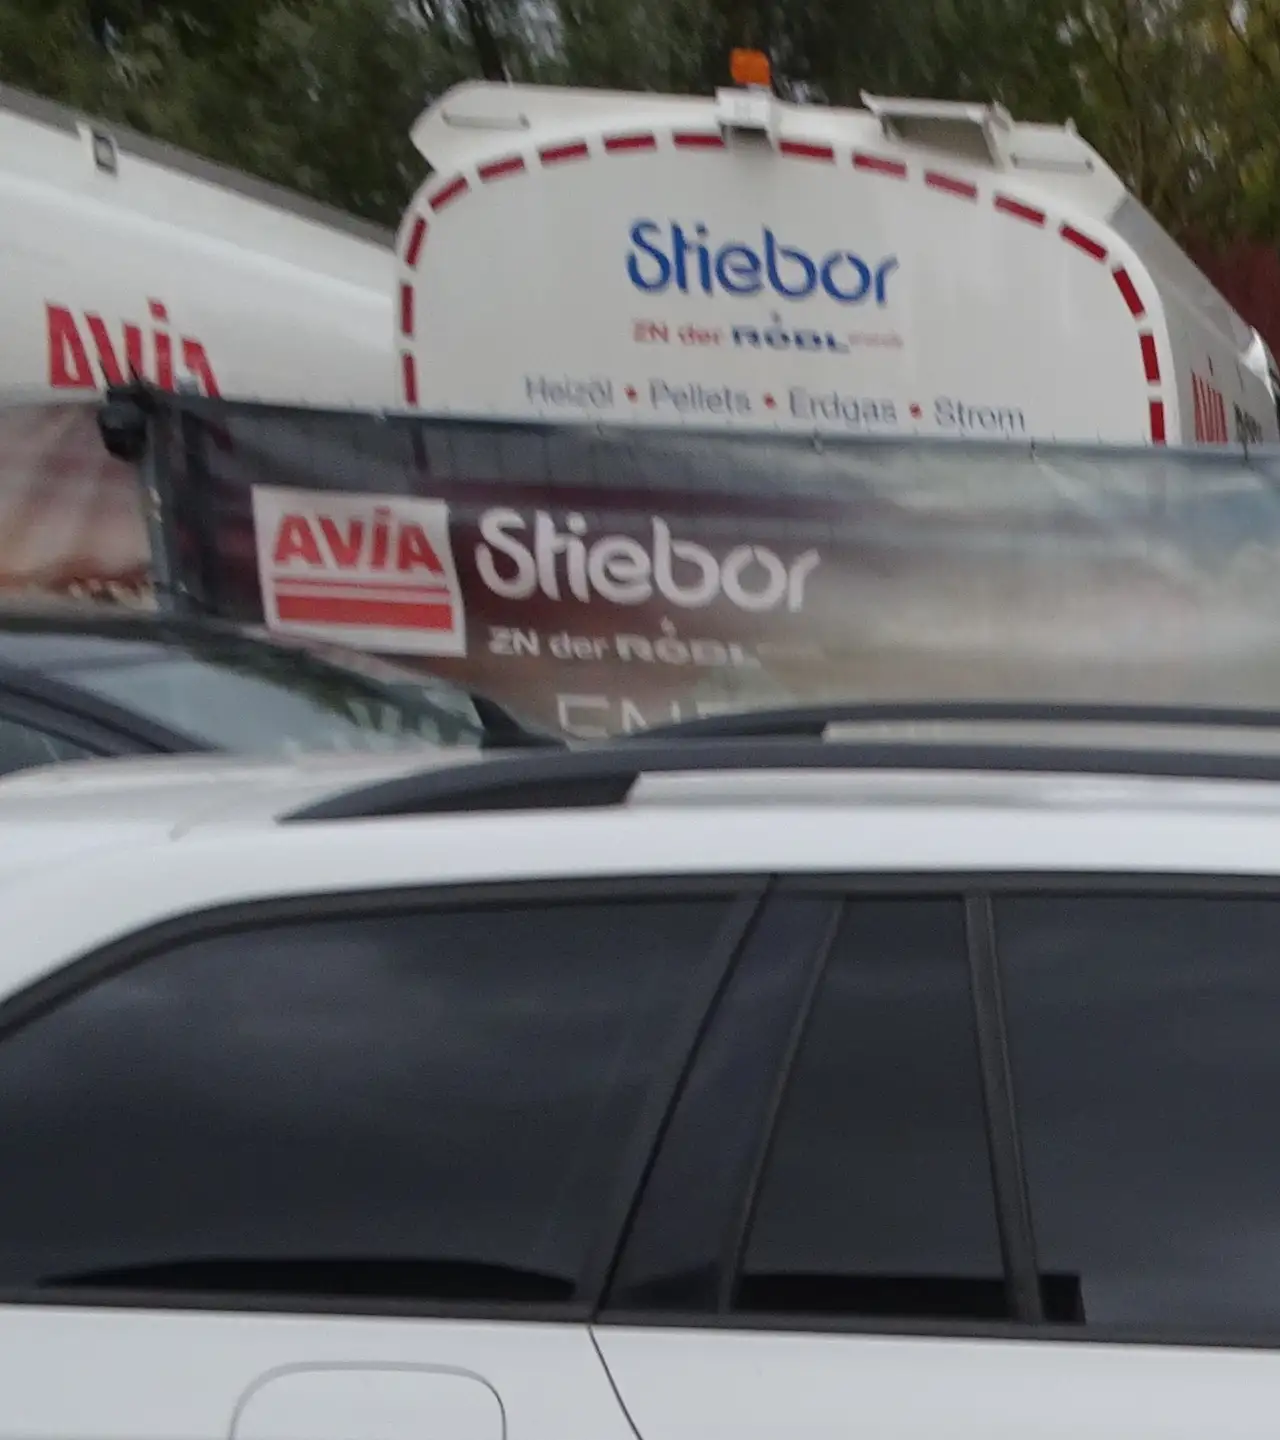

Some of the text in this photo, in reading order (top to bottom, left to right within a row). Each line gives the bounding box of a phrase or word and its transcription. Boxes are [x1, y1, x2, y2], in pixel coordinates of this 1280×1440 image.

[627, 218, 899, 307] Stiebor
[650, 378, 751, 416] Pellets
[788, 387, 898, 429] Erdgas
[934, 397, 1026, 432] Strom
[476, 507, 821, 611] Stiebor
[548, 631, 609, 660] der
